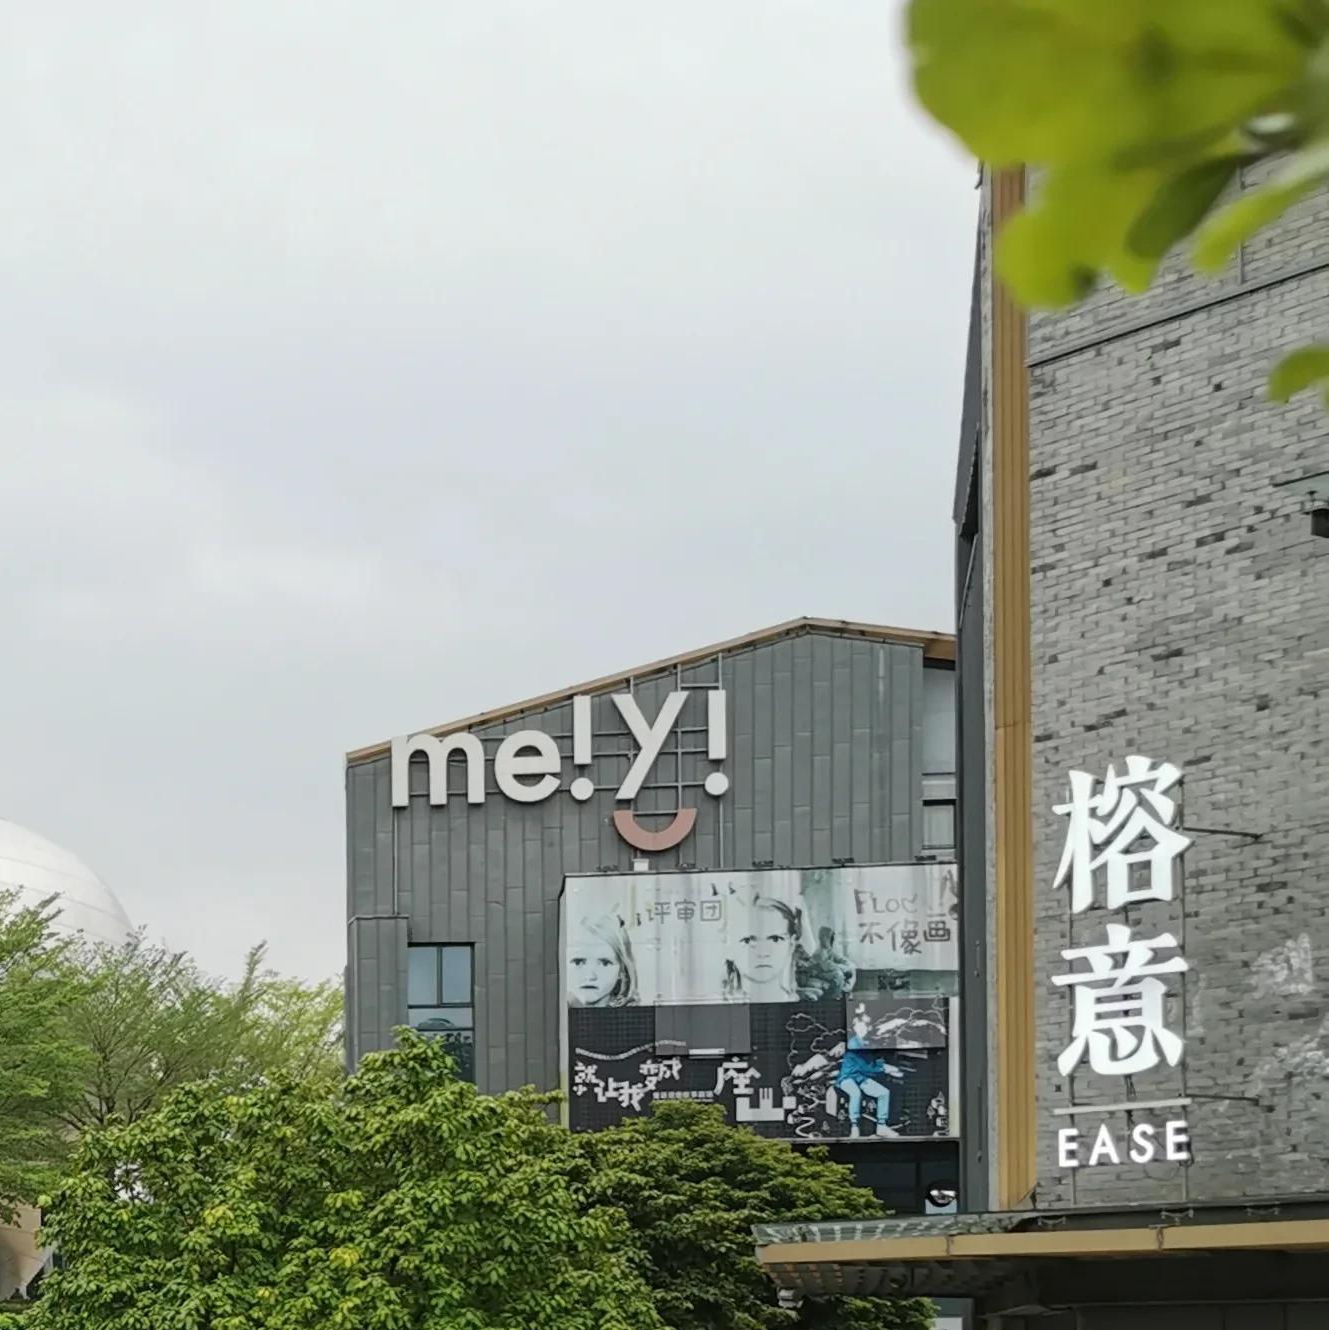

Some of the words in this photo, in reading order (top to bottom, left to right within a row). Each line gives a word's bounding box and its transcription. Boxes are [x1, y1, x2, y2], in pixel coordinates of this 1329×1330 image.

[858, 913, 950, 954] 不像画
[1052, 755, 1193, 1076] 榕意
[1057, 1121, 1191, 1167] EASE
